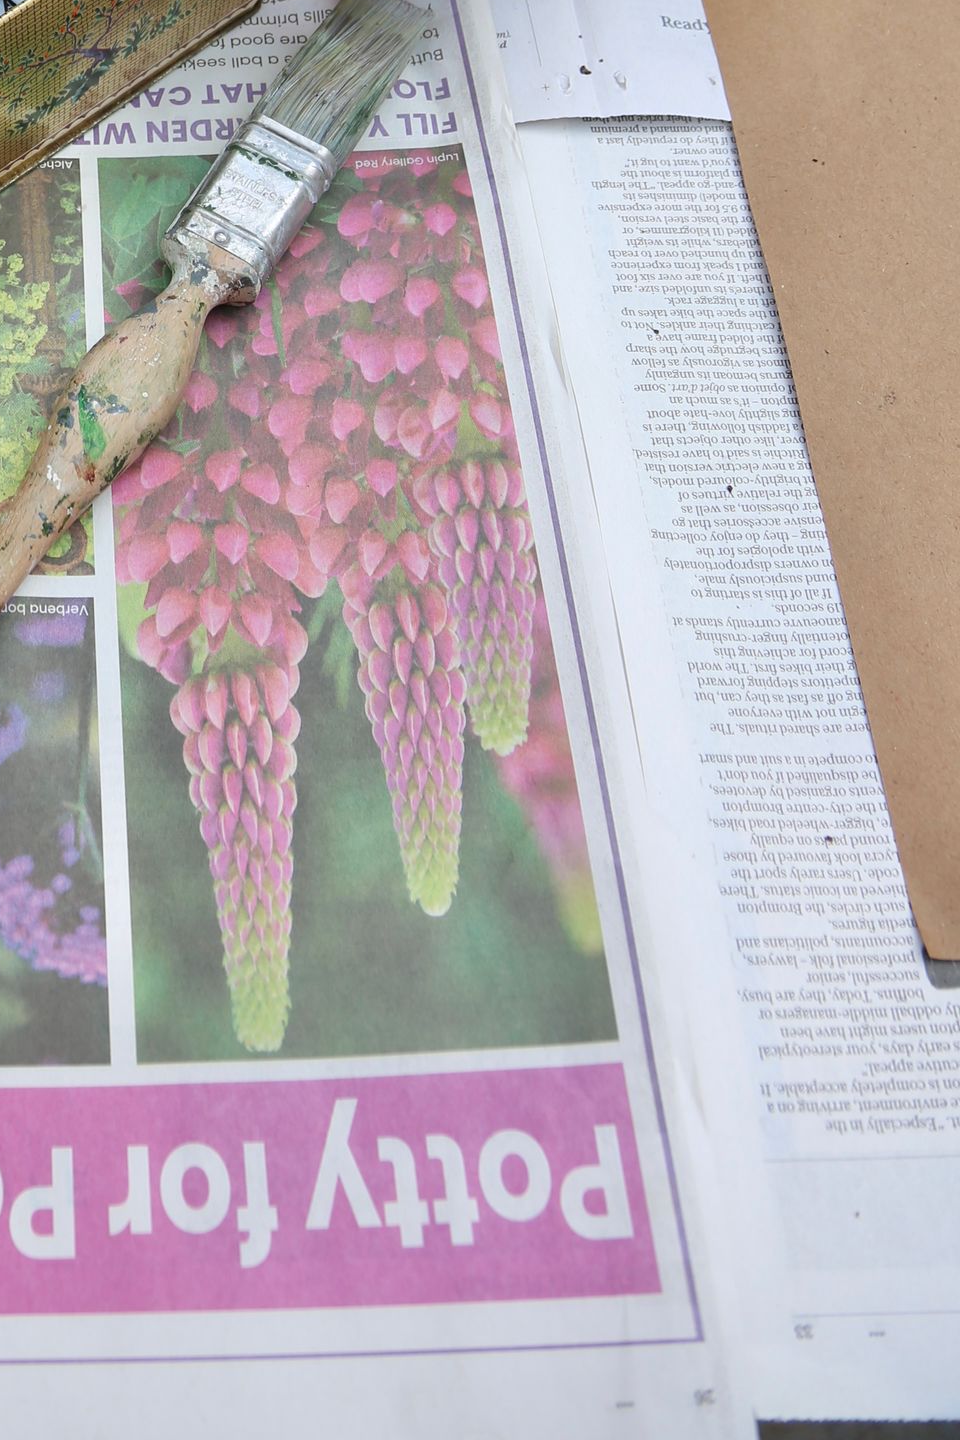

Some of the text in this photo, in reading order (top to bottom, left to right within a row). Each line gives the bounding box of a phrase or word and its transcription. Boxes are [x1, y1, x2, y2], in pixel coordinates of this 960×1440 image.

[239, 14, 298, 28] brimmi
[231, 33, 275, 48] good
[280, 35, 307, 45] are
[232, 56, 262, 67] ball
[269, 56, 278, 64] a
[202, 82, 266, 103] HAT
[397, 112, 457, 136] FILL
[591, 125, 702, 134] command premium
[627, 136, 678, 145] reputedly
[355, 152, 459, 169] Lupin Gallery Red
[684, 169, 729, 179] platform
[638, 192, 697, 201] diminishes
[598, 203, 652, 212] expensive
[618, 214, 661, 223] version,
[638, 226, 709, 236] kilogrammes,
[626, 237, 663, 247] weight
[611, 260, 671, 270] experience
[662, 285, 711, 294] unfolded
[694, 296, 737, 306] luggage
[656, 321, 775, 332] catching ankles.
[626, 343, 760, 356] begrudge sharp
[631, 357, 740, 368] vigorously fellow
[645, 369, 758, 381] bemoan ungainly
[683, 409, 780, 421] slightly love-hate
[688, 422, 790, 433] faddish following,
[677, 435, 718, 446] objects
[632, 448, 804, 459] Ritchie resisted,
[669, 463, 759, 473] electric version
[696, 474, 799, 487] brightly-coloured
[737, 490, 781, 499] relative
[30, 604, 89, 617] Verbena
[786, 770, 859, 784] disqualified
[709, 784, 846, 799] organised devotees,
[737, 900, 801, 915] Brompton
[305, 1097, 635, 1249] Potty
[108, 1140, 278, 1269] for
